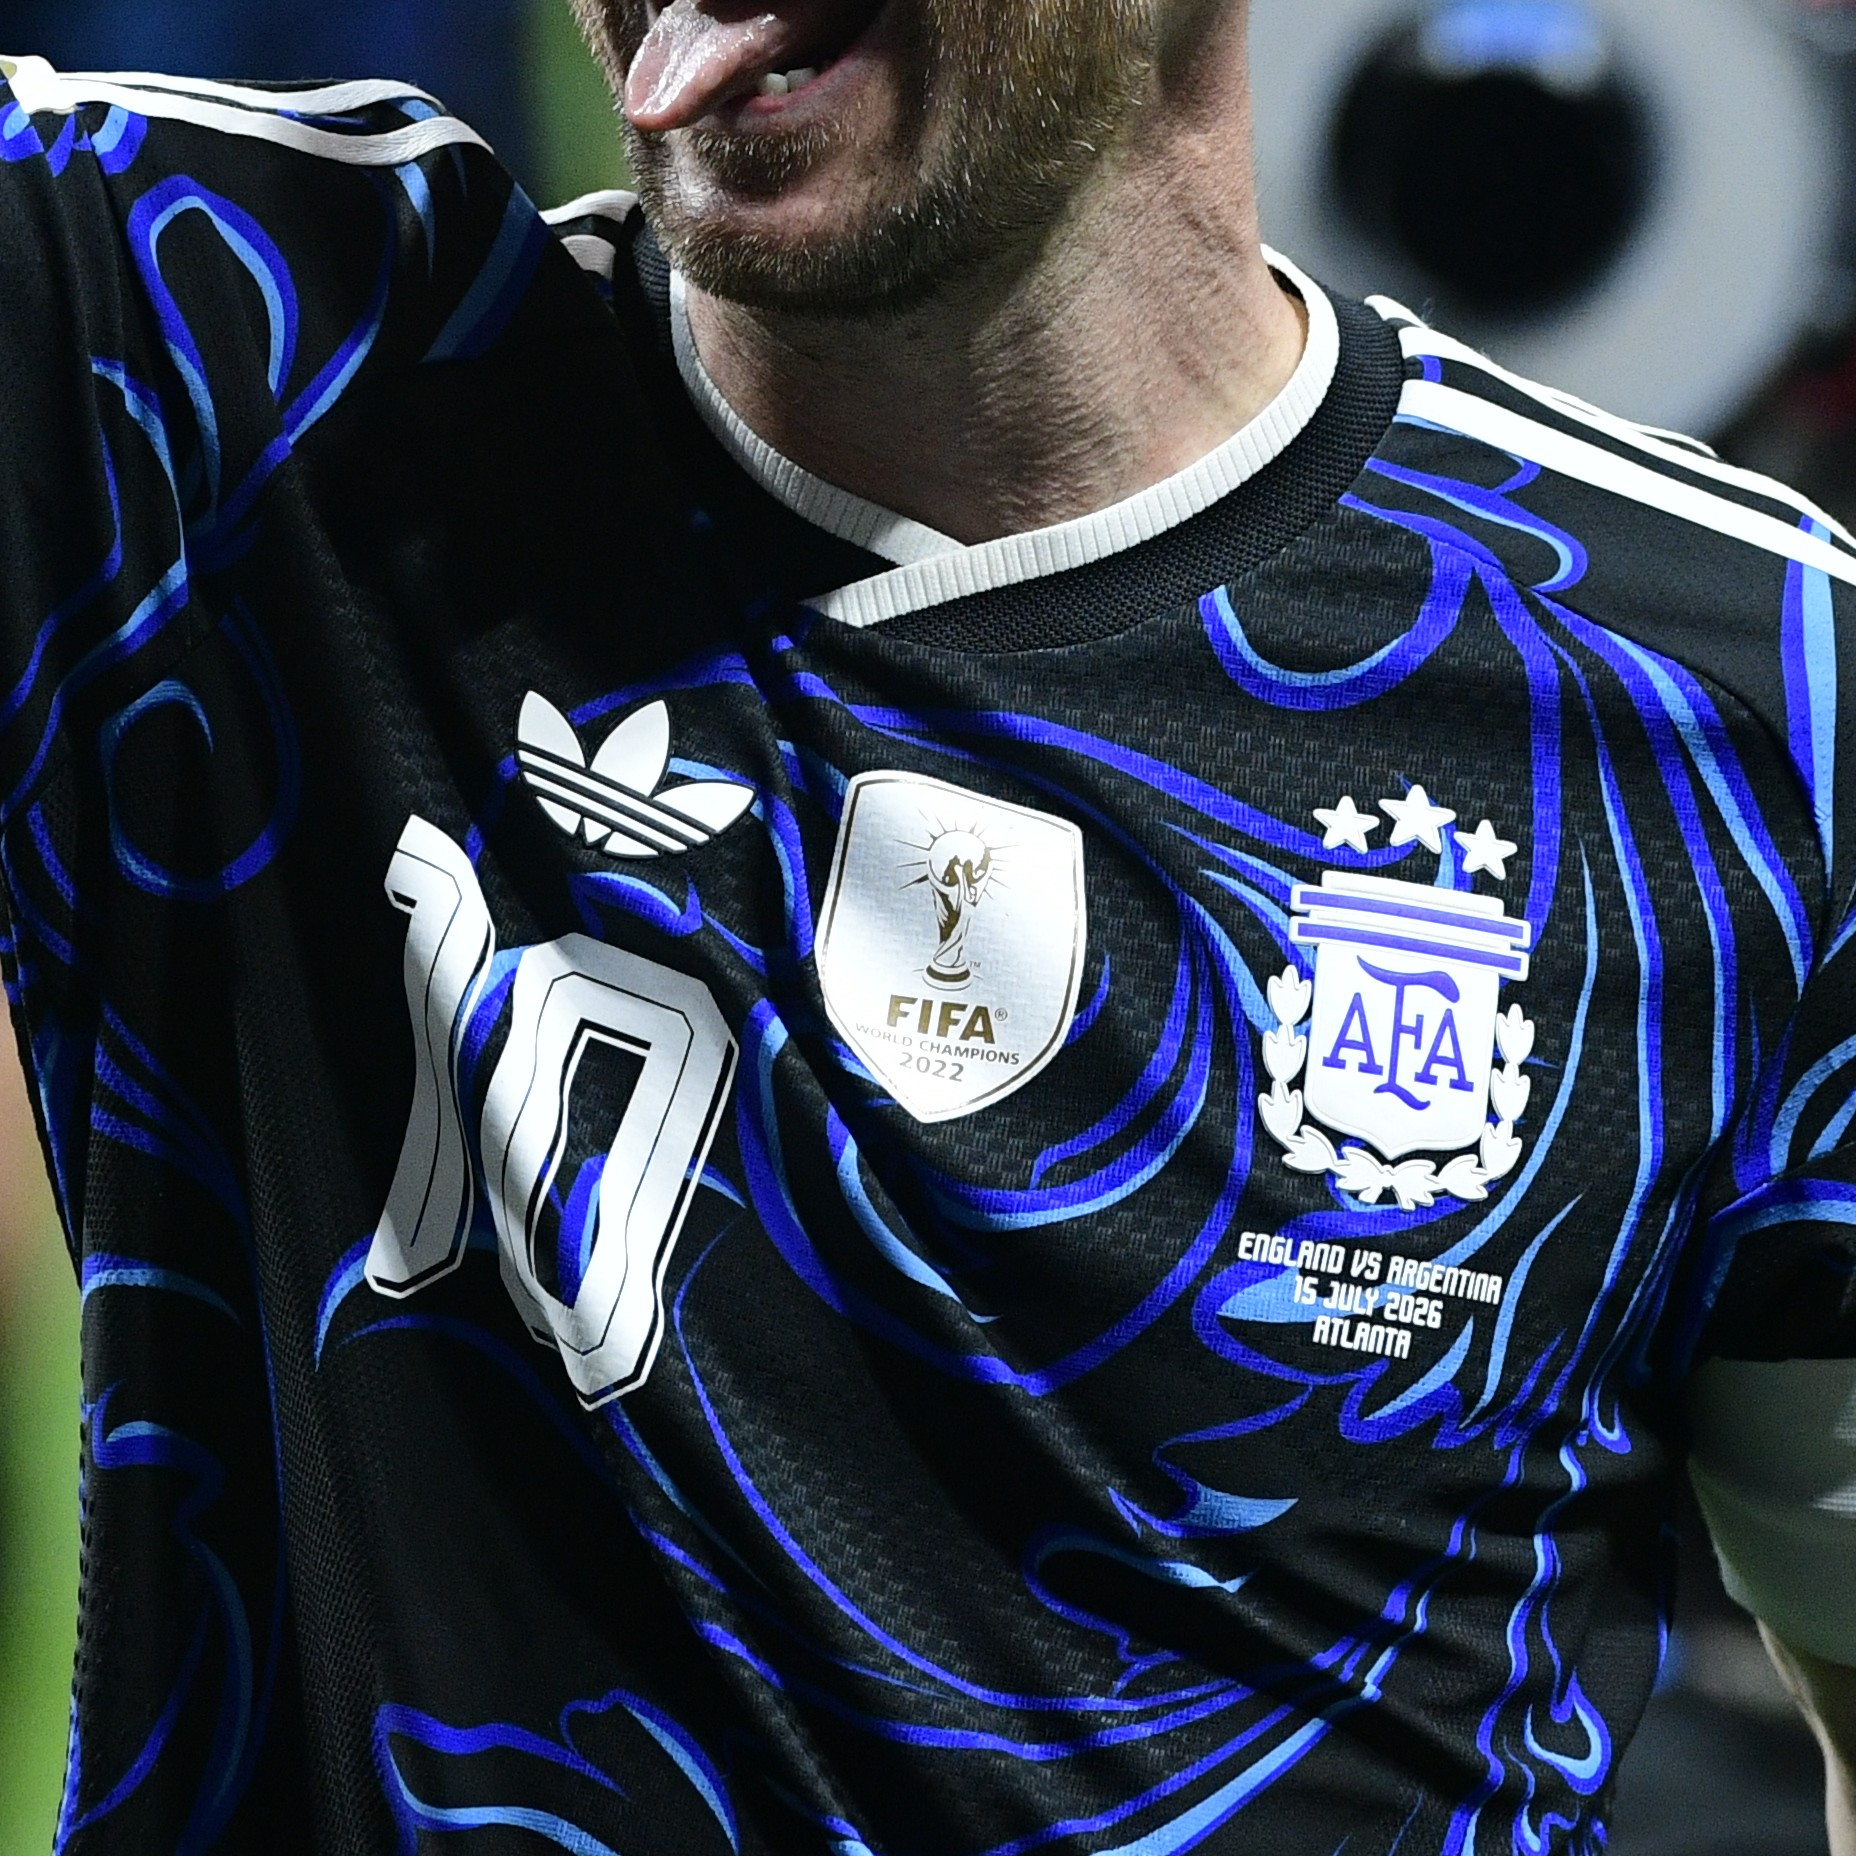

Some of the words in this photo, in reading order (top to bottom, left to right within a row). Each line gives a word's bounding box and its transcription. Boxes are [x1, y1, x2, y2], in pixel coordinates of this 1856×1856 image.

[855, 1022, 913, 1047] WORLD
[919, 1040, 1020, 1065] CHAMPIONS
[1322, 955, 1474, 1111] AFA
[899, 1052, 965, 1082] 2022
[363, 812, 740, 1413] 10
[1237, 1231, 1346, 1275] ENGLAND
[1350, 1249, 1383, 1281] VS
[1386, 1255, 1503, 1305] ARGENTINA
[1294, 1276, 1319, 1306] 15
[1322, 1280, 1380, 1317] JULY
[1383, 1292, 1444, 1329] 2026
[1312, 1315, 1412, 1359] ATLANTA
